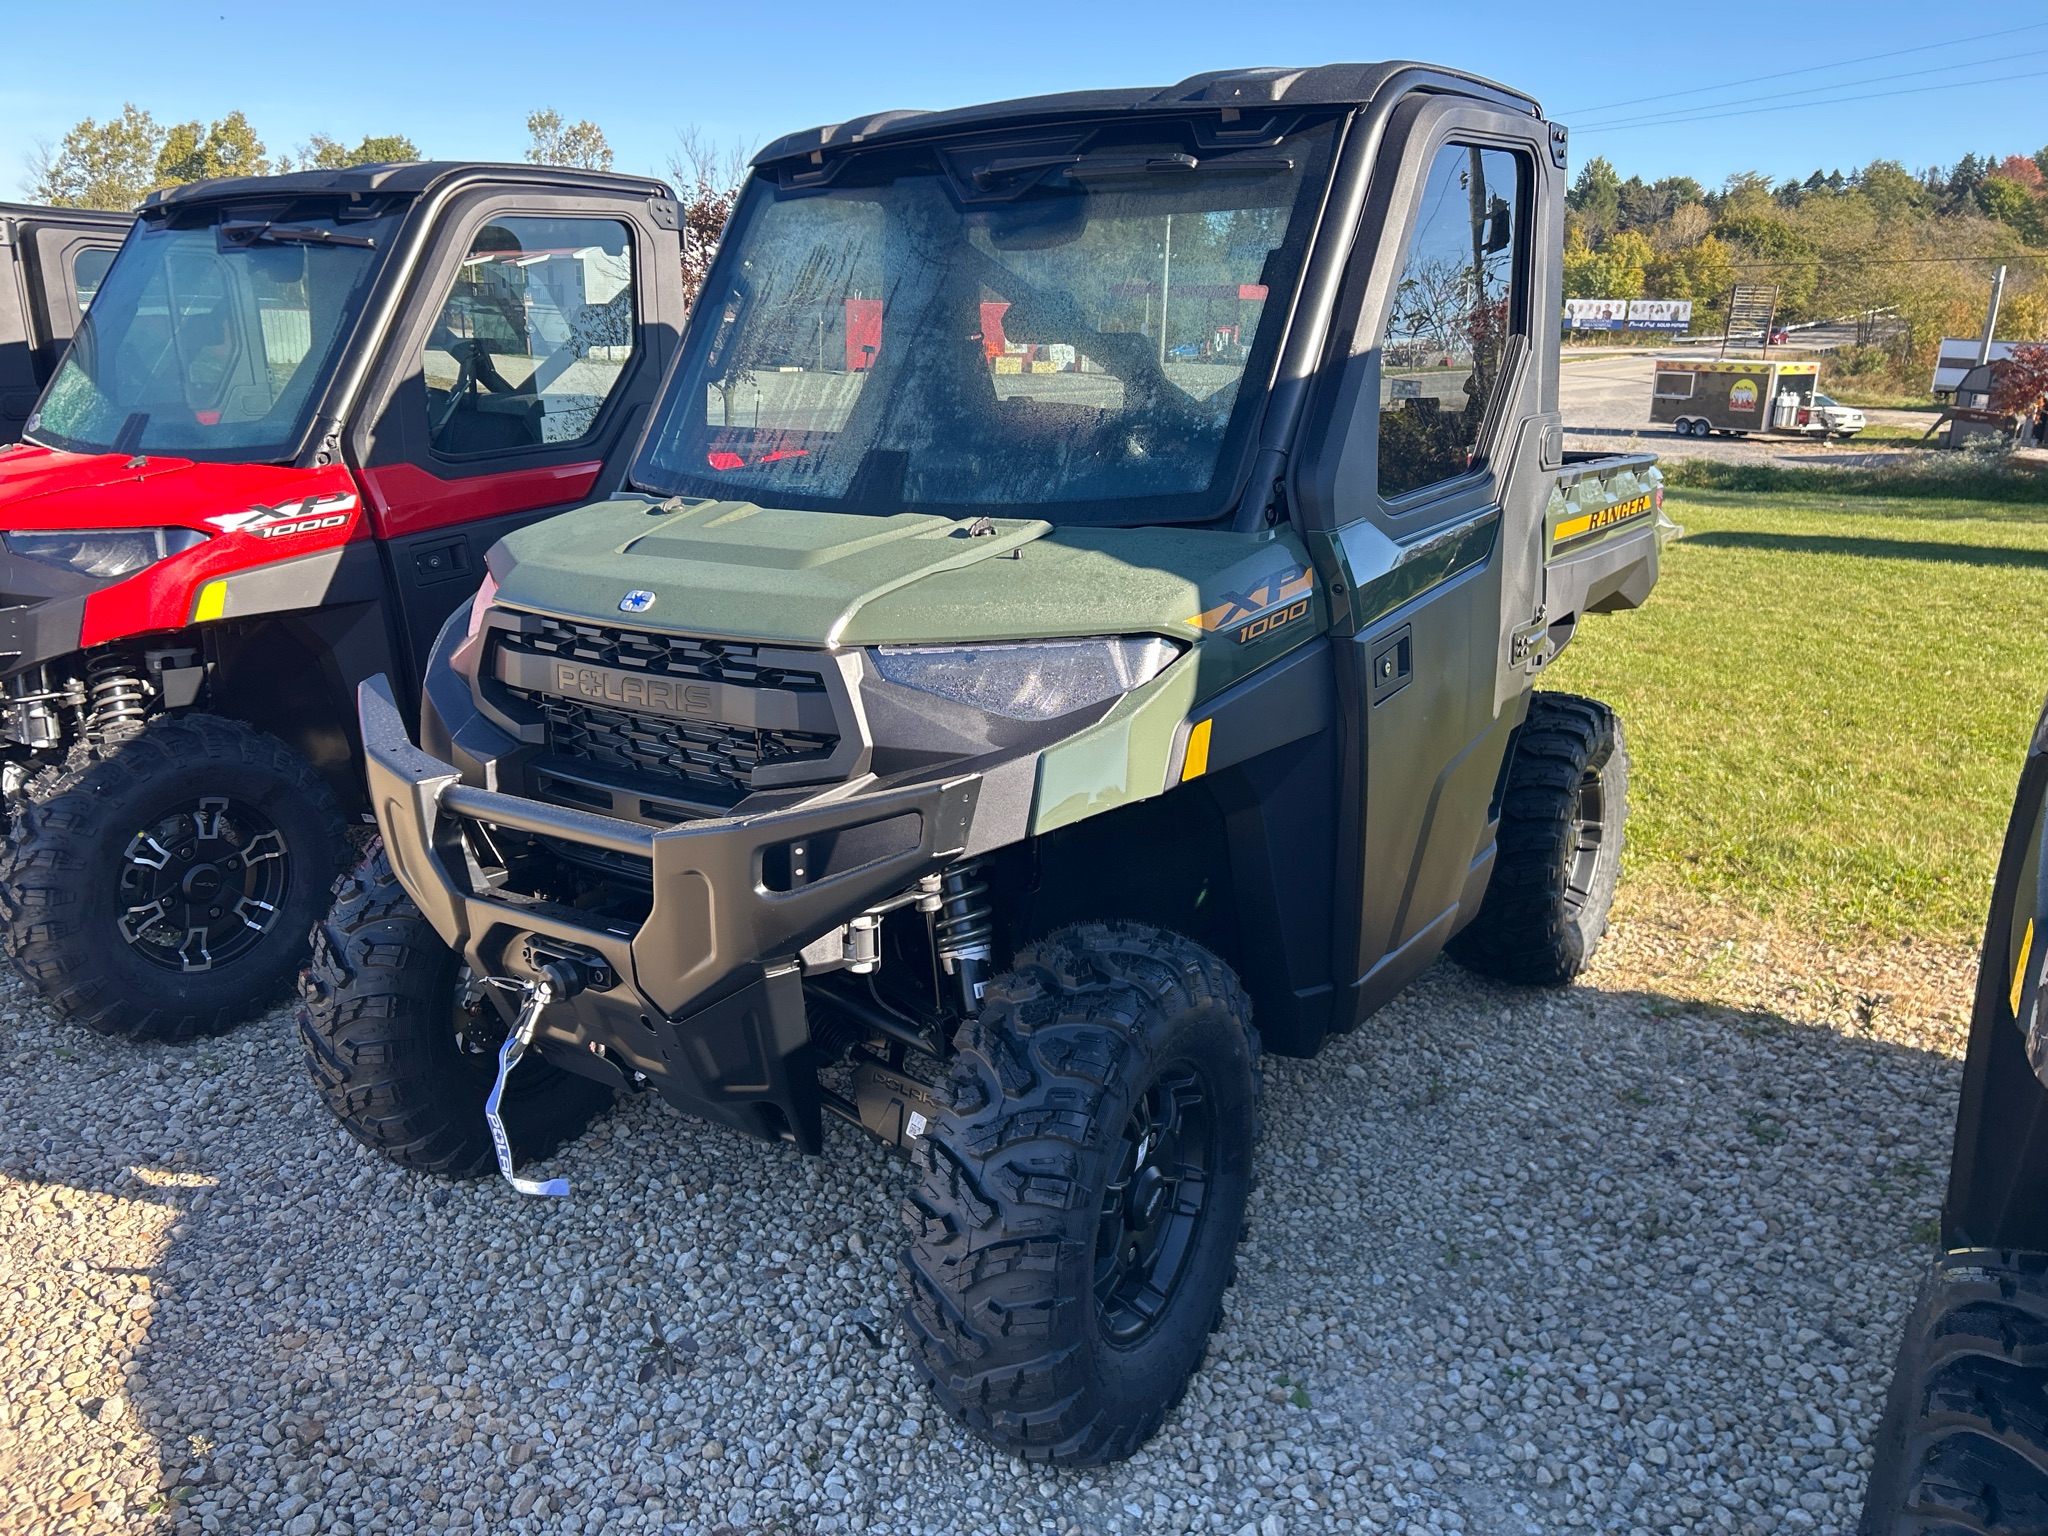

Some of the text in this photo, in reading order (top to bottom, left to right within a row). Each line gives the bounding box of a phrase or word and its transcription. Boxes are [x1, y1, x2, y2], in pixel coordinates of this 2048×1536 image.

[237, 491, 350, 526] XP
[263, 515, 346, 538] 1000
[1588, 496, 1646, 531] RANGER
[1214, 563, 1308, 629] XP
[1240, 599, 1308, 643] 1000
[557, 664, 713, 714] POLARIS
[873, 1072, 939, 1109] POLAR
[487, 1113, 514, 1184] POLAR
